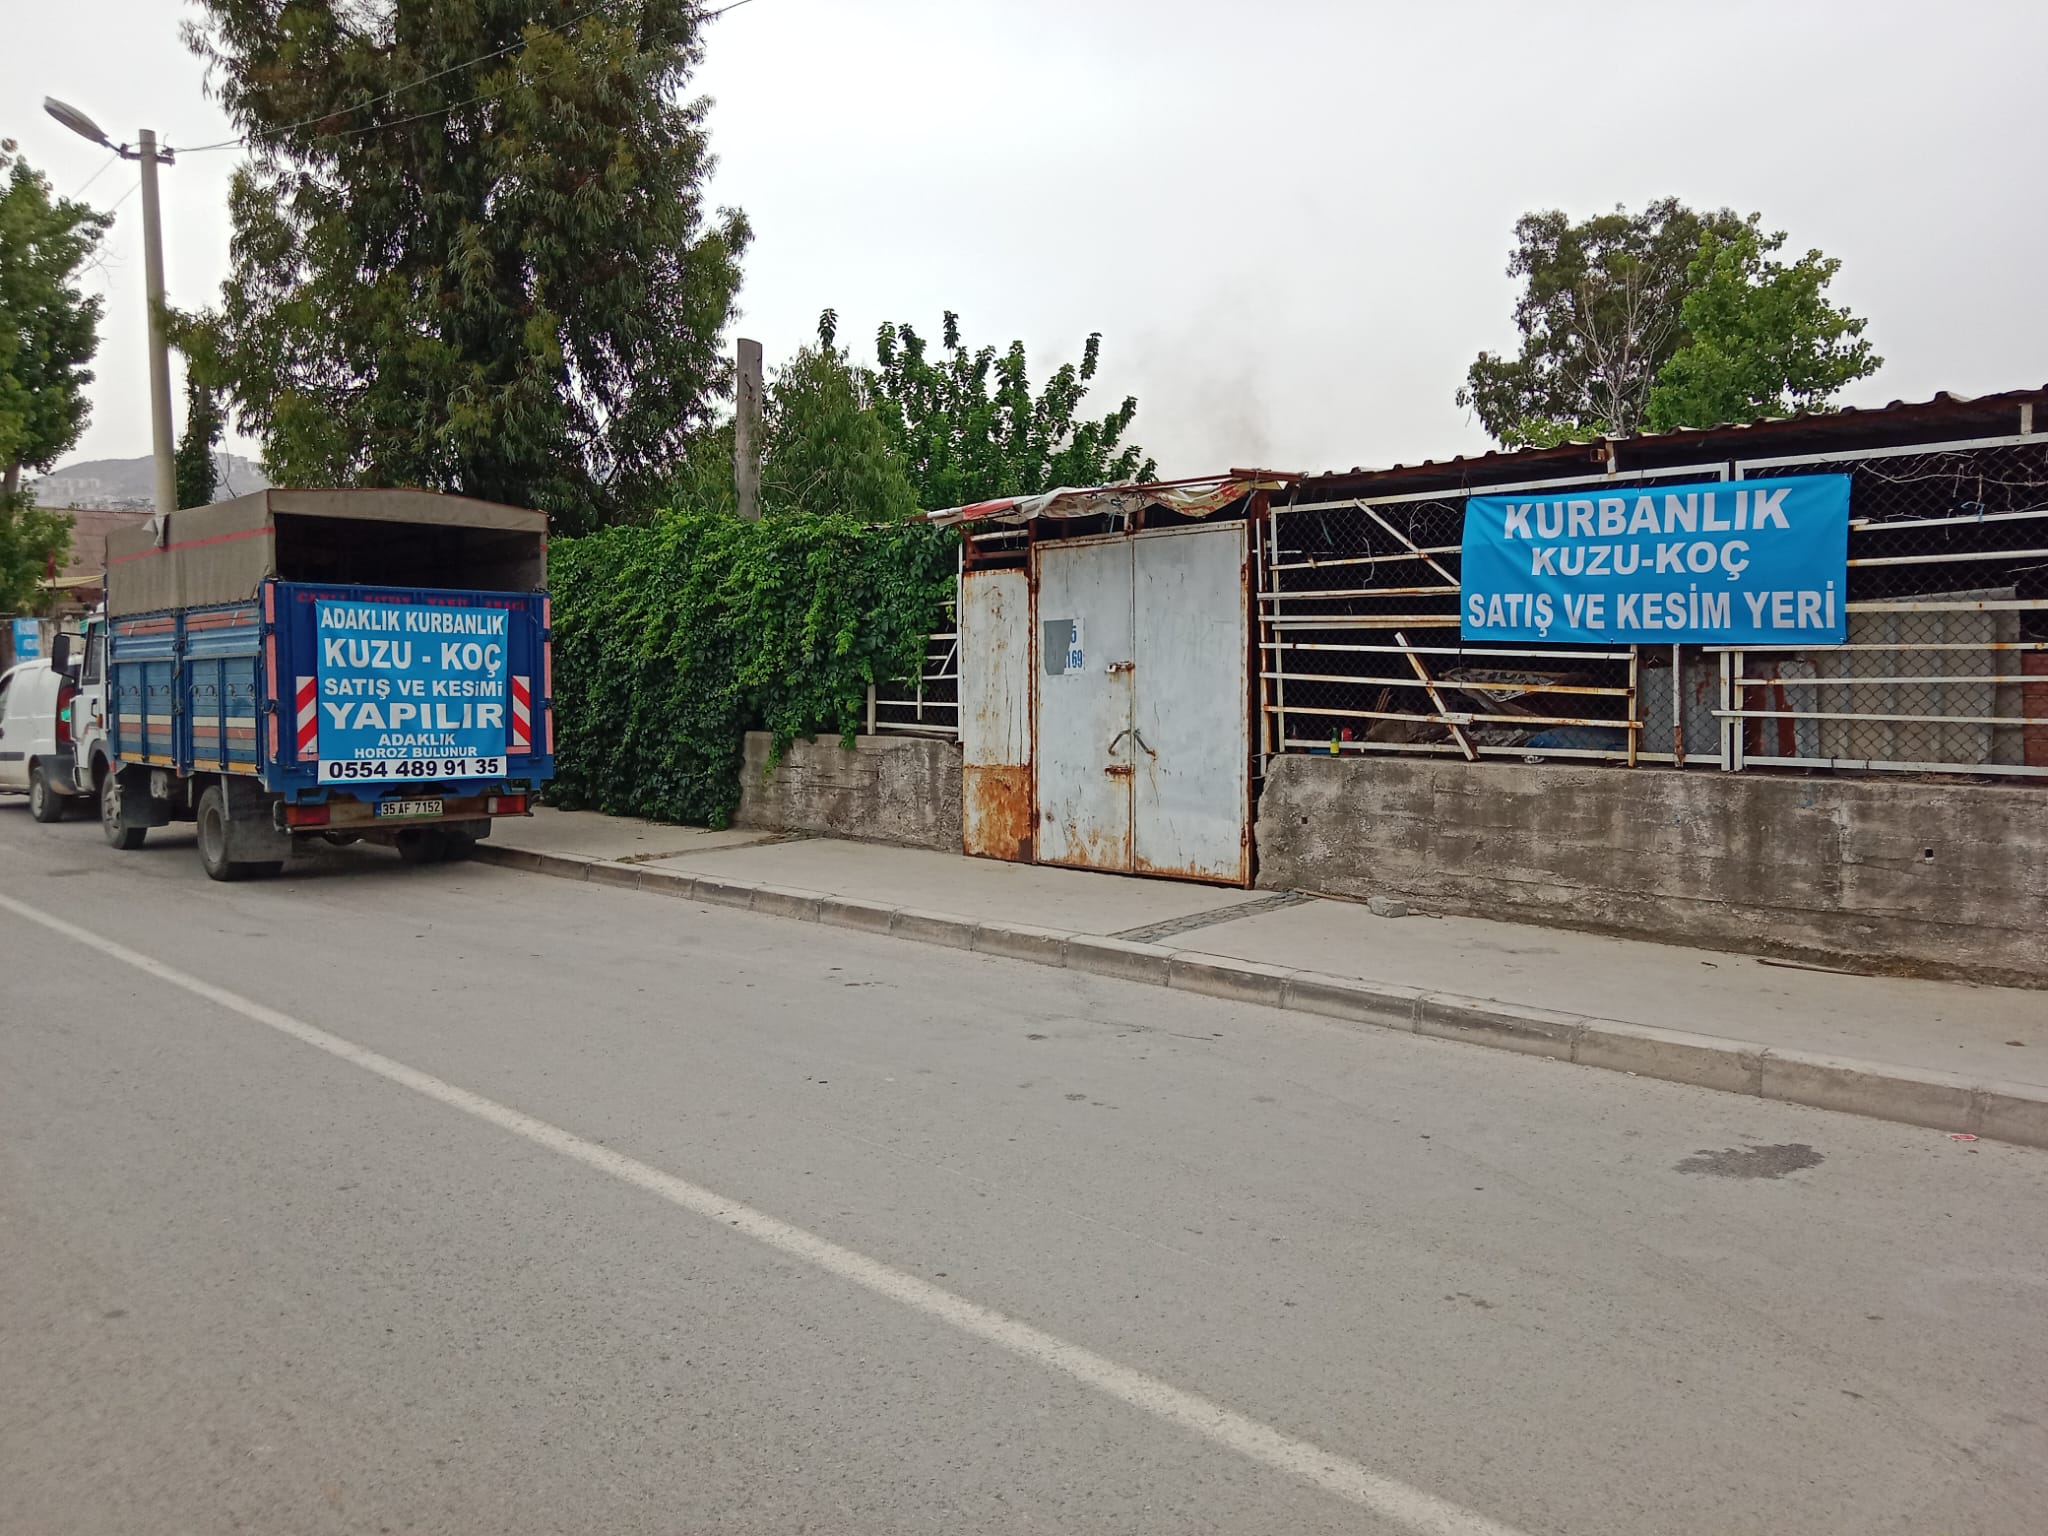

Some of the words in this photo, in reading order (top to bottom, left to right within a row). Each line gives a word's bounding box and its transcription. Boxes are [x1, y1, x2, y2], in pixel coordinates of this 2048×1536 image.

[1504, 488, 1793, 540] KURBANLIK
[1531, 540, 1750, 581] KUZU-KOÇ
[321, 608, 400, 631] ADAKLIK
[406, 611, 504, 635] KURBANLIK
[1468, 593, 1554, 638] SATIŞ
[1564, 593, 1605, 629] VE
[1616, 583, 1731, 630] KESİM
[1743, 580, 1835, 629] YERİ
[324, 638, 412, 669] KUZU
[441, 642, 501, 678] KOÇ
[324, 678, 391, 700] SATIŞ
[397, 679, 425, 696] VE
[322, 702, 504, 730] YAPILIR
[354, 748, 408, 759] HOROZ
[412, 746, 478, 758] BULUNUR
[378, 733, 456, 746] ADAKLIK
[329, 761, 388, 779] 0554
[395, 761, 438, 777] 489
[444, 759, 467, 776] 91
[475, 758, 499, 775] 35
[382, 804, 396, 815] 35
[398, 803, 411, 814] AF
[415, 801, 441, 813] 7152
